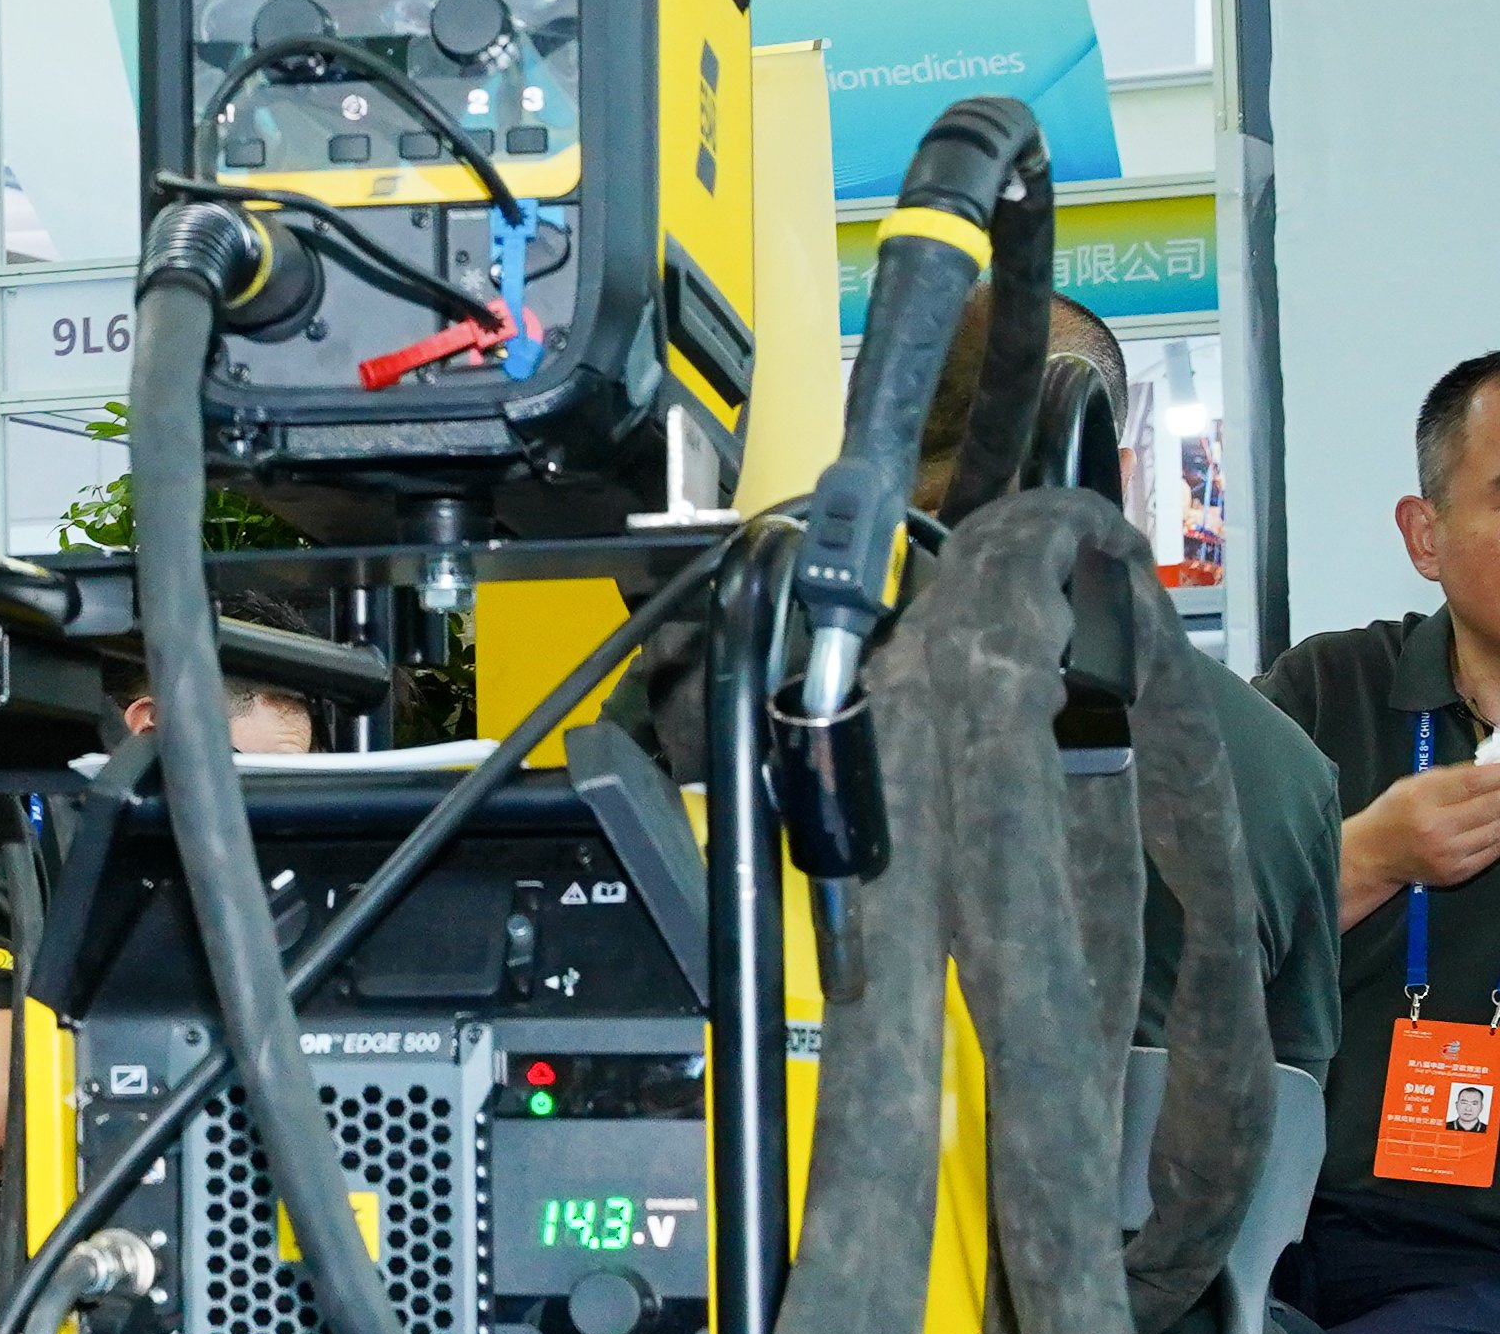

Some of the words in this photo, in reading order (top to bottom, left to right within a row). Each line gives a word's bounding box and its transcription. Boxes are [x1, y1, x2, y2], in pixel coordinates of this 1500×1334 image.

[827, 51, 1026, 92] iomedicines
[467, 88, 490, 115] 2
[521, 85, 545, 112] 3
[343, 1032, 402, 1054] EDGE
[403, 1031, 442, 1053] 500
[541, 1196, 634, 1250] 14.3
[646, 1214, 676, 1249] V
